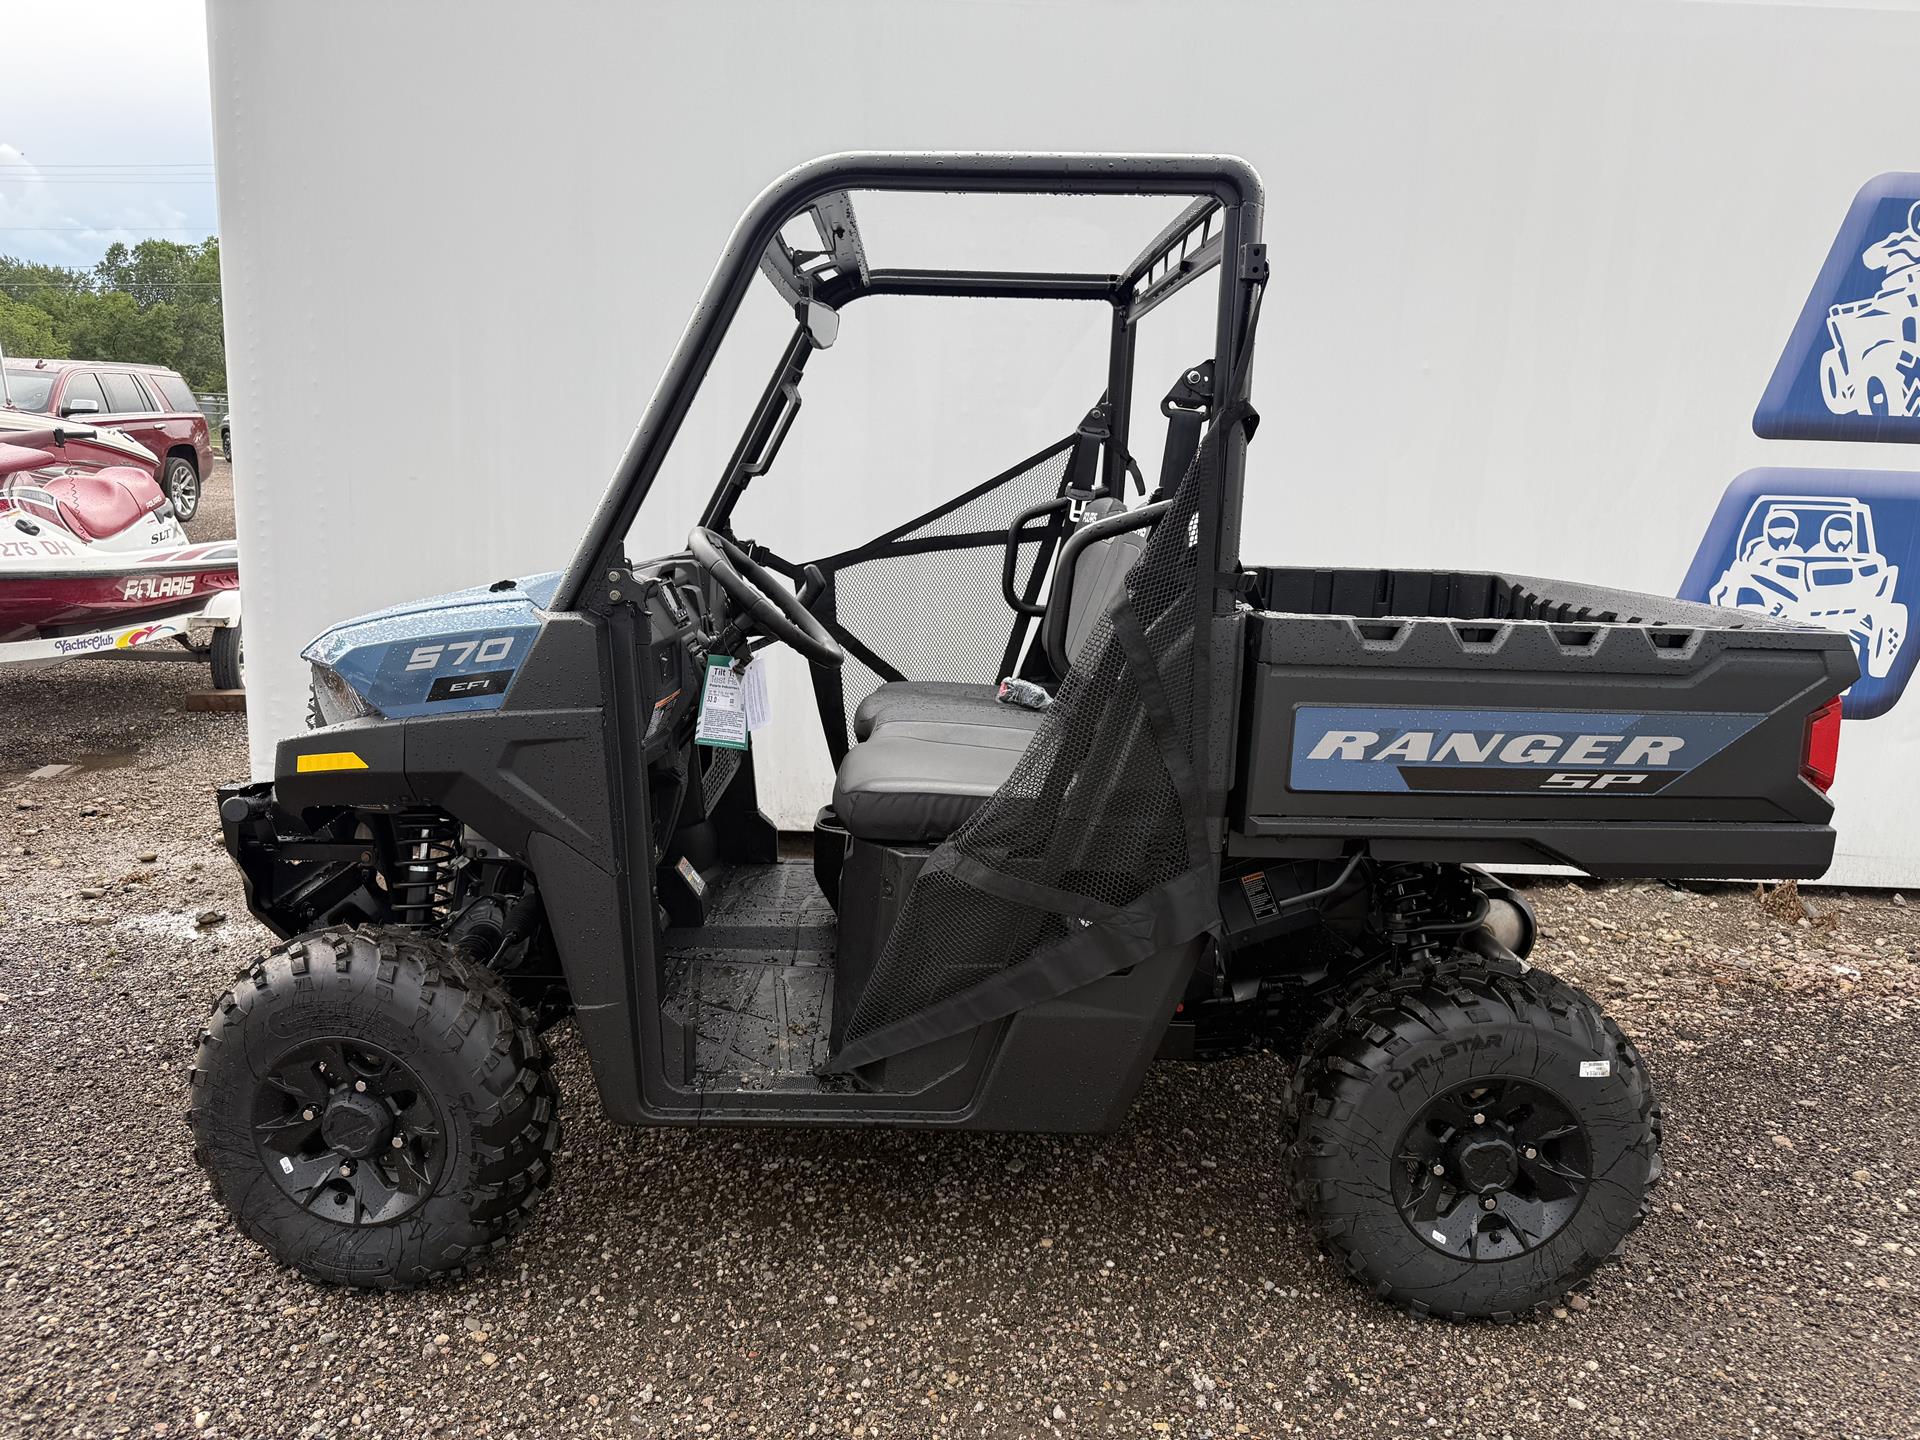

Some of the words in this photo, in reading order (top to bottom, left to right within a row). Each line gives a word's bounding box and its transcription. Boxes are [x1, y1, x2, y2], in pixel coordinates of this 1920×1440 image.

[39, 540, 76, 556] DH
[123, 576, 196, 601] POLARIS
[405, 637, 515, 671] 570
[711, 675, 726, 684] Test
[714, 667, 726, 676] Tilt
[449, 680, 490, 692] EFI
[1306, 730, 1686, 766] RANGER
[1539, 773, 1649, 790] SP
[1387, 1033, 1503, 1094] CARLSTAR
